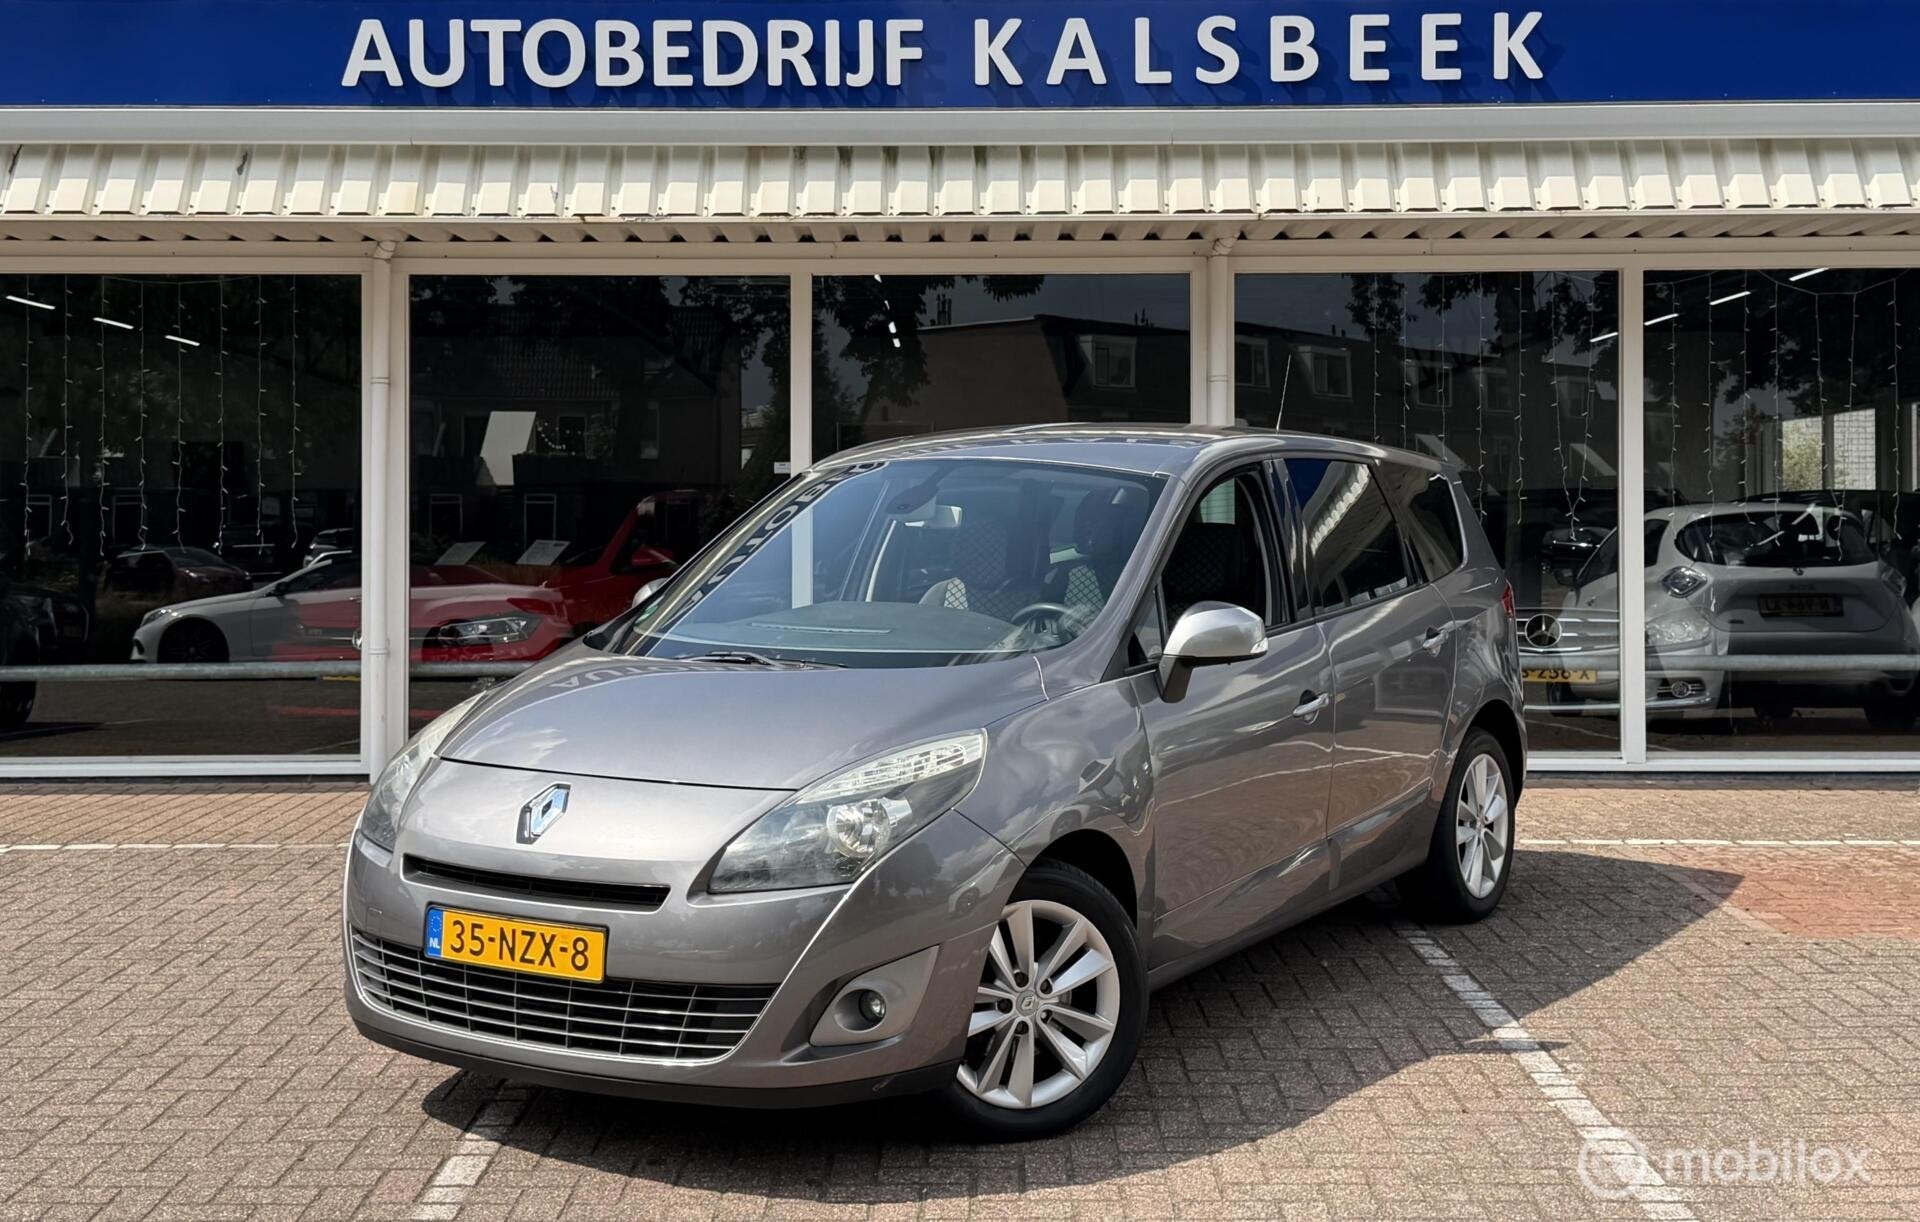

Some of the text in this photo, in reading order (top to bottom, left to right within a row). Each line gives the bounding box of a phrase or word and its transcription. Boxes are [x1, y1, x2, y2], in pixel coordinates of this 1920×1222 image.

[341, 11, 1543, 88] AUTOBEDRIJF KALSBEEK
[429, 936, 441, 949] NL
[450, 919, 589, 972] 35-NZX-8
